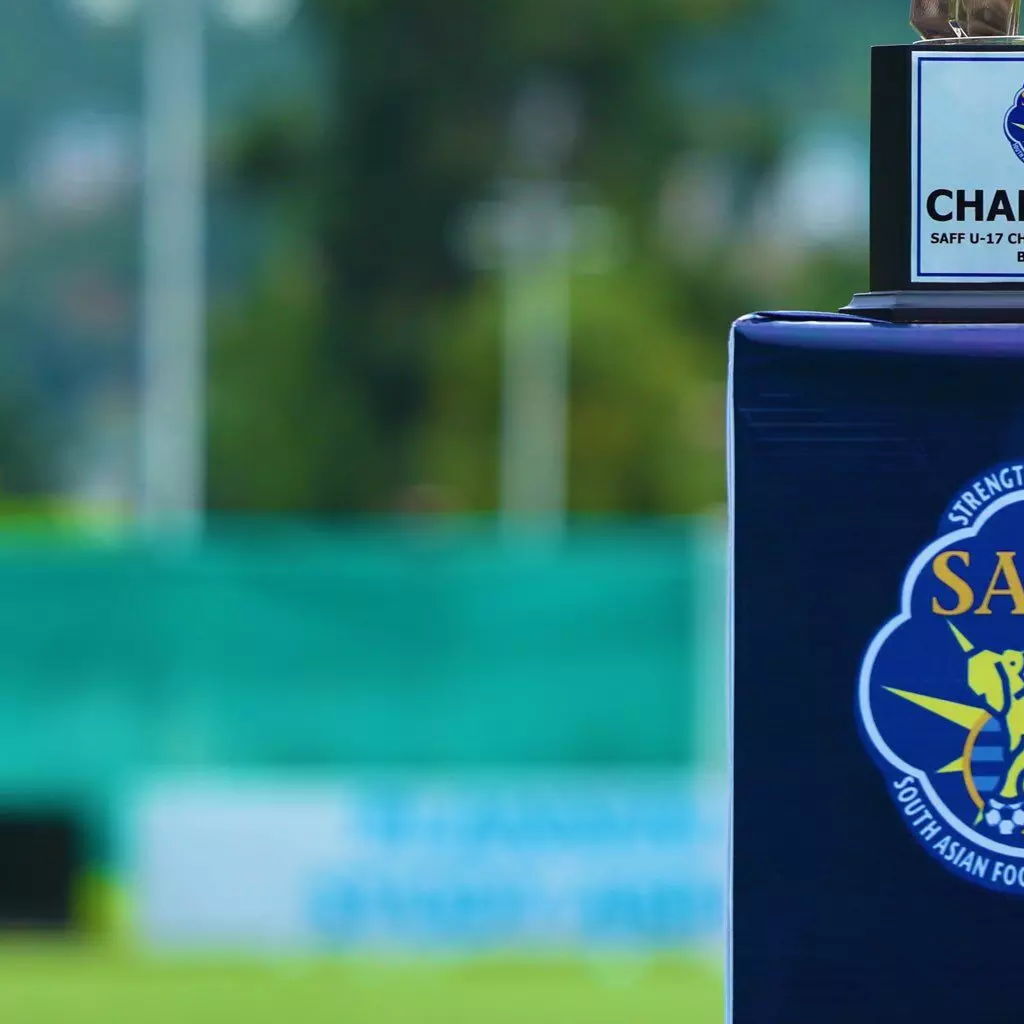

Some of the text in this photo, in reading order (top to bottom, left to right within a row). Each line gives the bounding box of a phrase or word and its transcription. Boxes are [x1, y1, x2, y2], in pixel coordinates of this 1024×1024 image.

[930, 232, 966, 244] SAFF
[969, 232, 1004, 244] U-17
[894, 776, 942, 840] SOUTH
[933, 836, 990, 878] ASIAN
